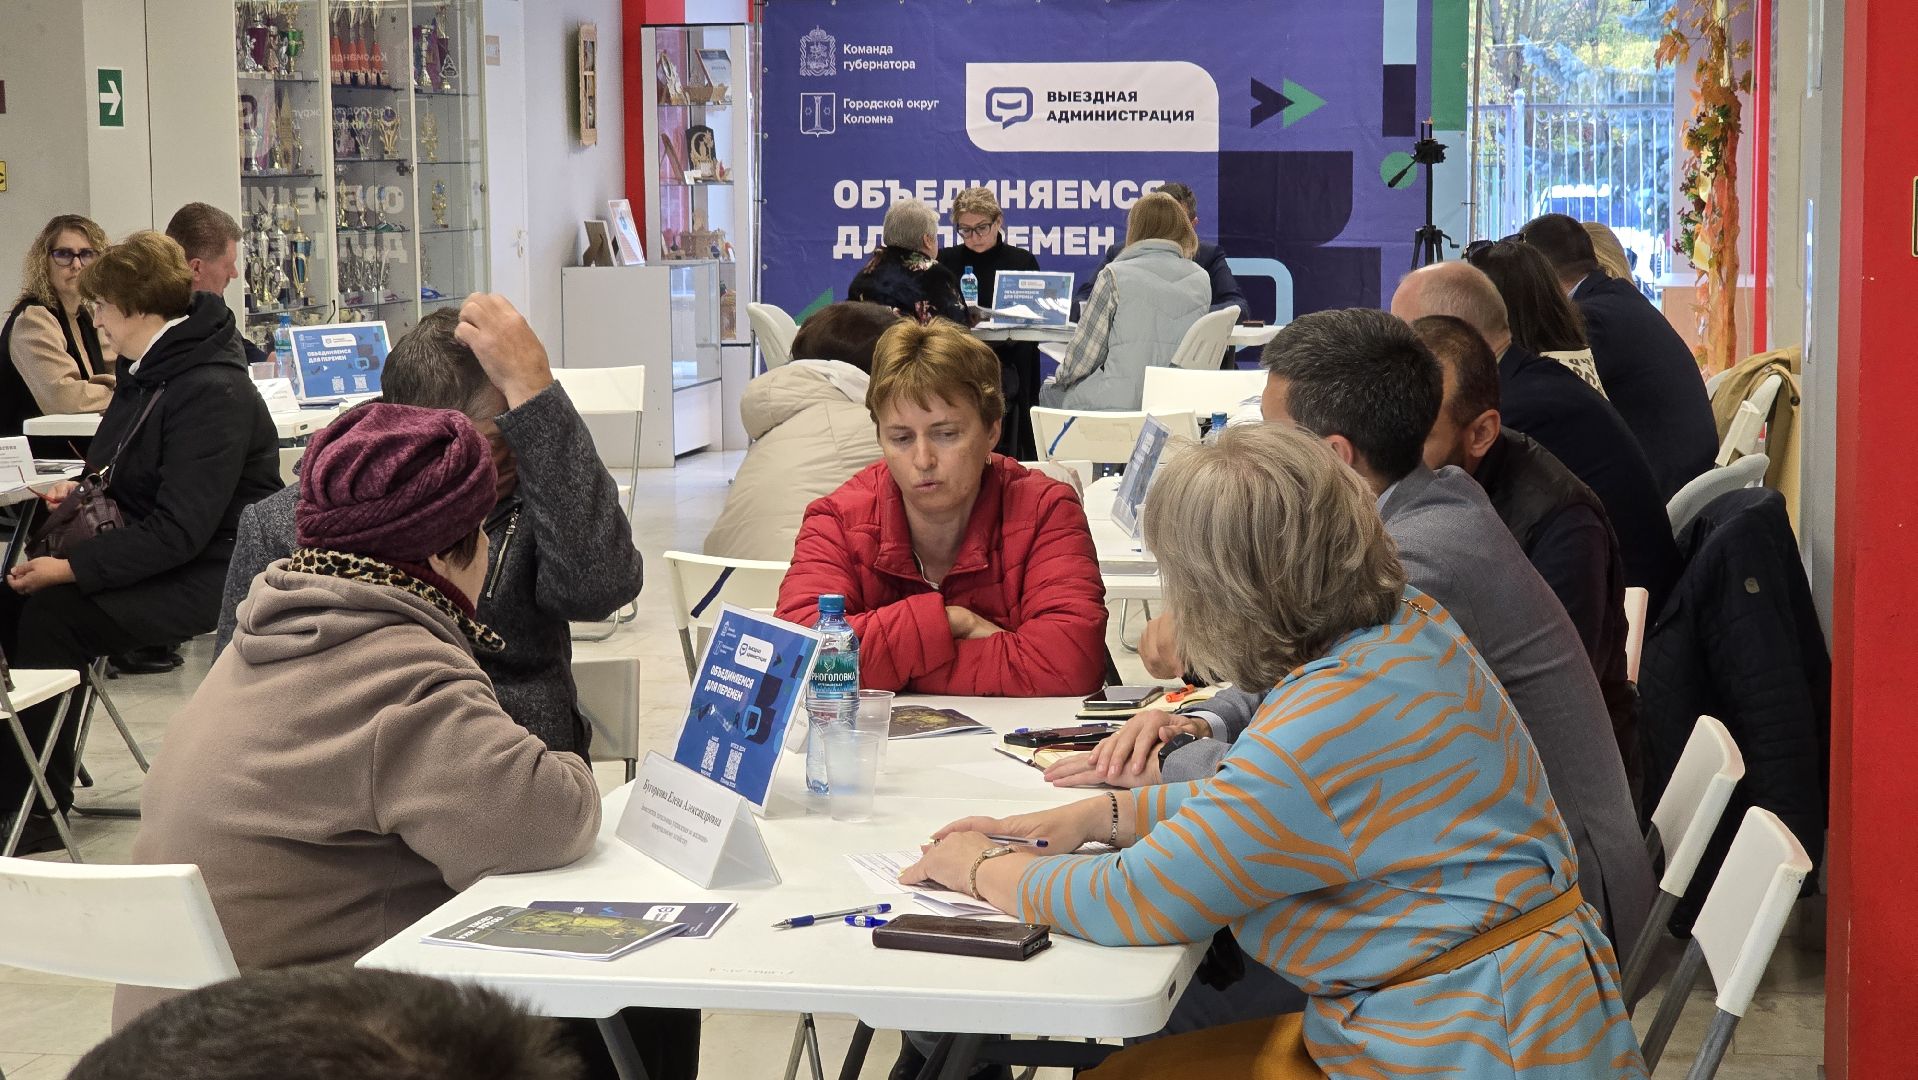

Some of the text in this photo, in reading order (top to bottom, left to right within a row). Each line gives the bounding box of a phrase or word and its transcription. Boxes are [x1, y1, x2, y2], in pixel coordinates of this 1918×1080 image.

[843, 43, 893, 55] Команда
[843, 59, 916, 71] губернатора
[1047, 91, 1138, 104] ВЫЕЗДНАЯ
[843, 98, 940, 111] Городской округ
[843, 113, 894, 124] Коломна
[1046, 110, 1195, 123] АДМИНИСТРАЦИЯ
[832, 225, 887, 260] ДЛ
[704, 680, 718, 693] ДЛЯ
